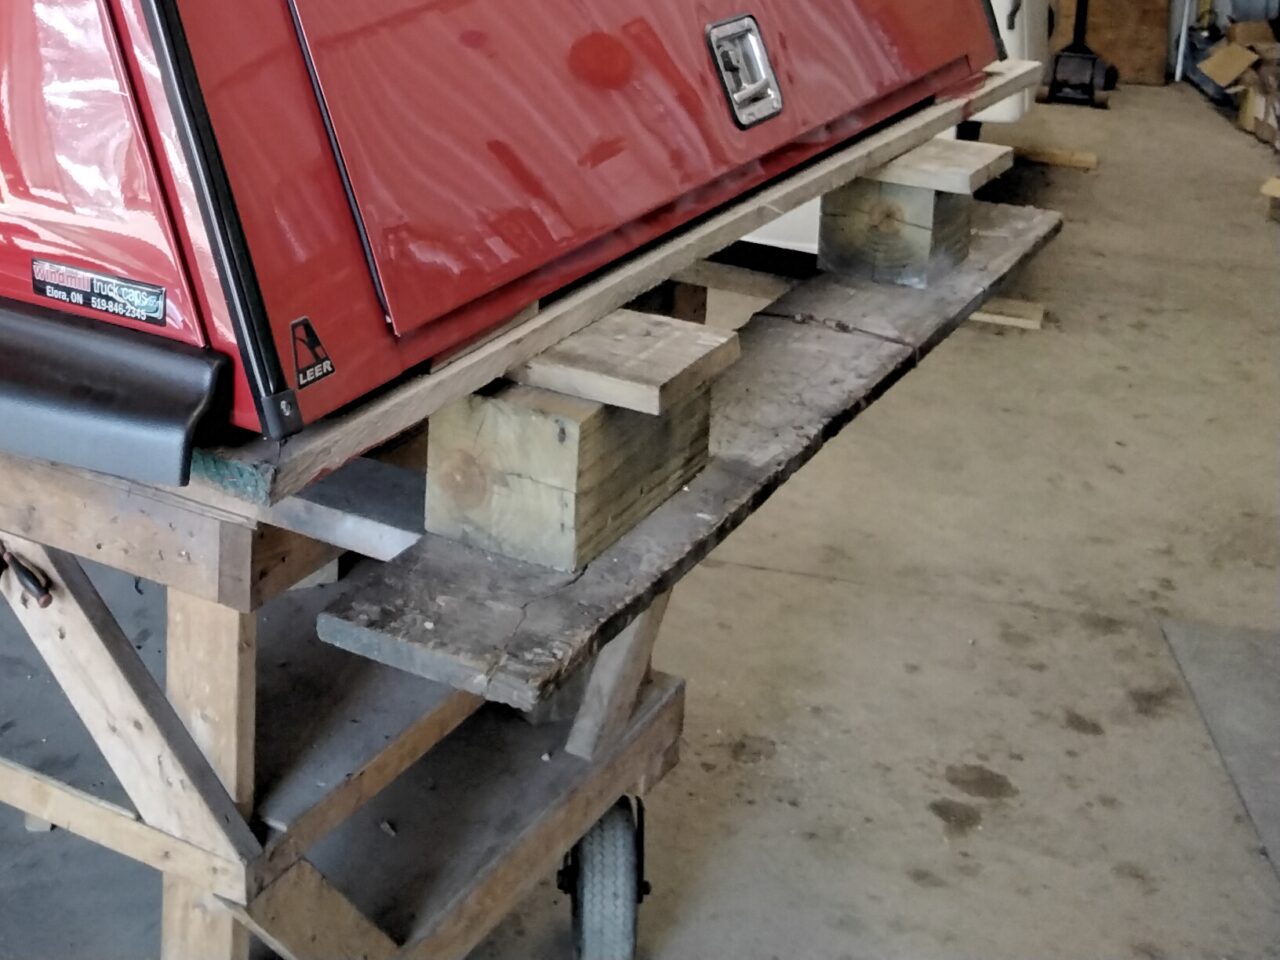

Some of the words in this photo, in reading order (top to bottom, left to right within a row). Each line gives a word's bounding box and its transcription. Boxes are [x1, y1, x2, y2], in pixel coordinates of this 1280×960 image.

[32, 260, 91, 293] windmill
[92, 277, 120, 297] truck
[121, 286, 149, 307] caps
[45, 285, 70, 302] Elora,
[70, 291, 84, 305] ON
[91, 296, 147, 321] 519-846-2345
[299, 359, 333, 386] LEER
